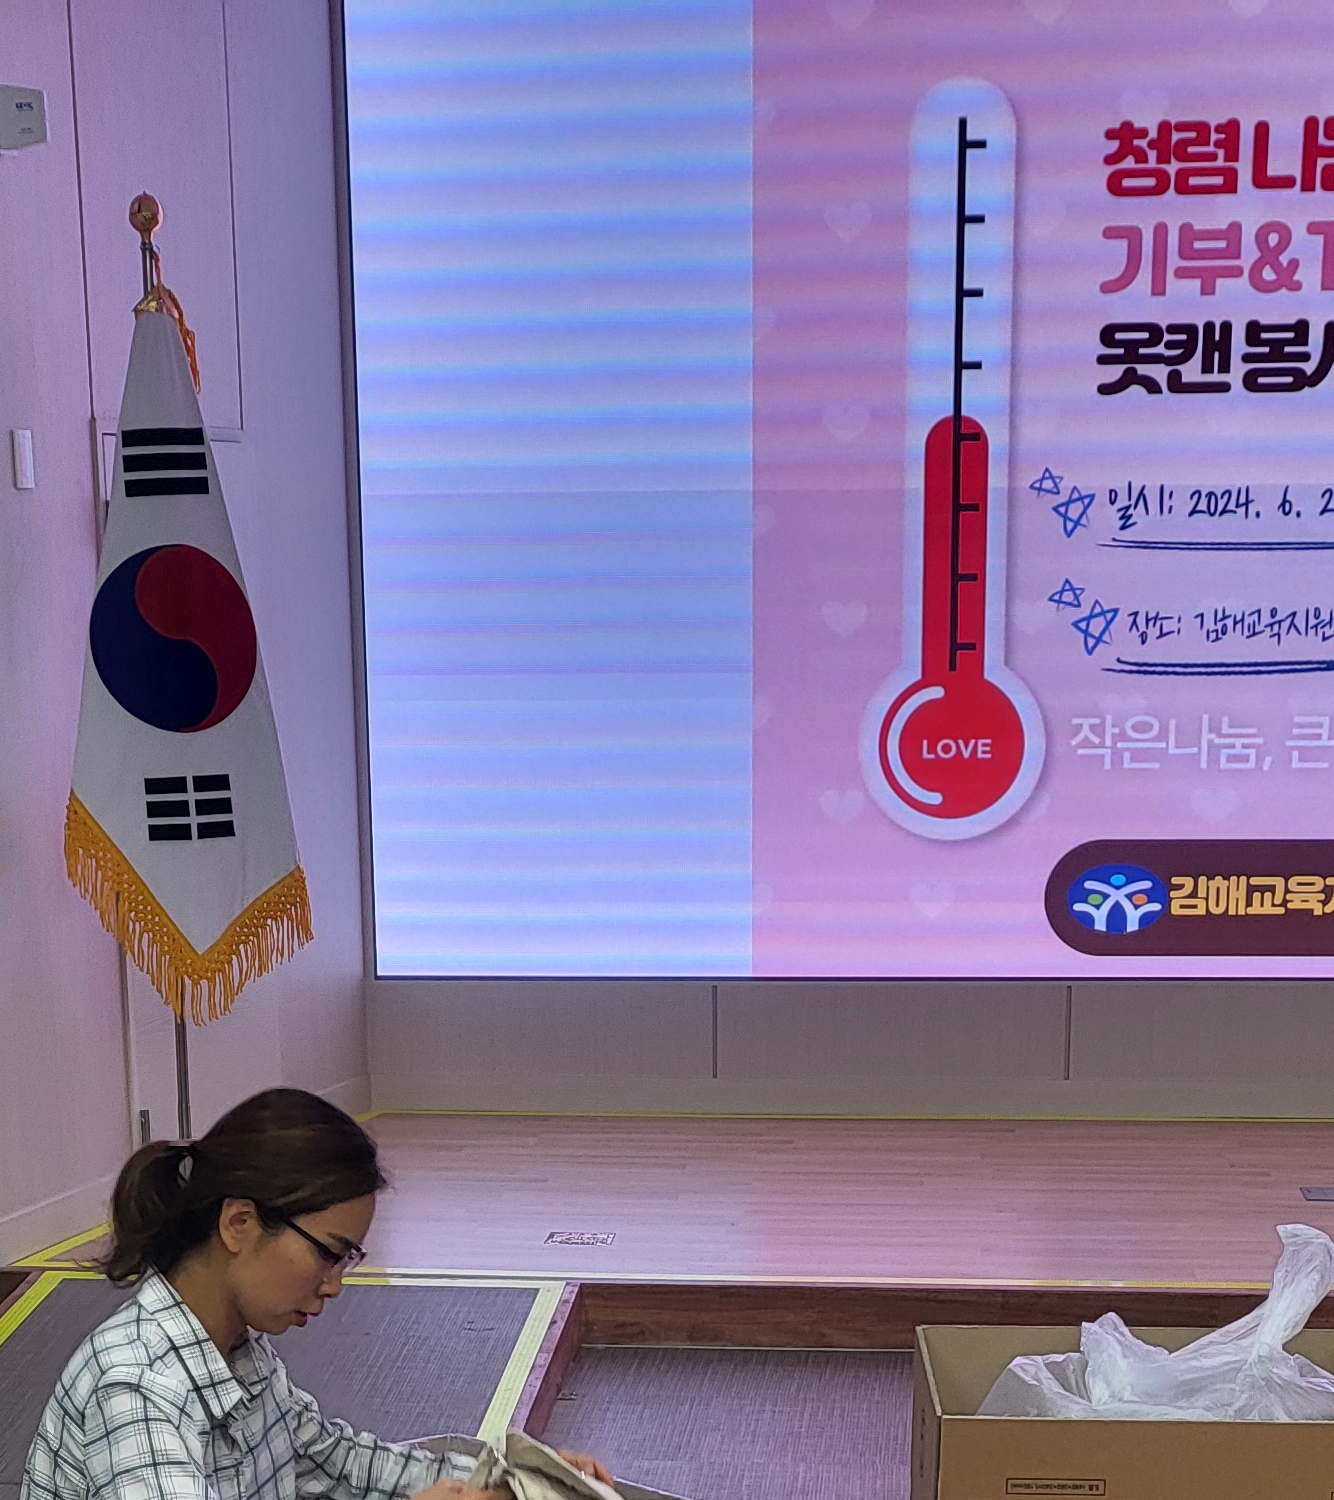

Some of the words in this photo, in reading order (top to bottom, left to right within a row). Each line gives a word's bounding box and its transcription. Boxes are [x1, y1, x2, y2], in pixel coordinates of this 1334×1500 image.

[1104, 120, 1240, 196] 청렴
[1096, 321, 1233, 396] 옷캔
[1108, 484, 1174, 532] 일시:
[1188, 487, 1262, 519] 2024.
[1277, 487, 1303, 518] 6.
[1126, 609, 1183, 642] 장소:
[921, 739, 992, 760] LOVE
[1070, 714, 1274, 772] 작은나눔,
